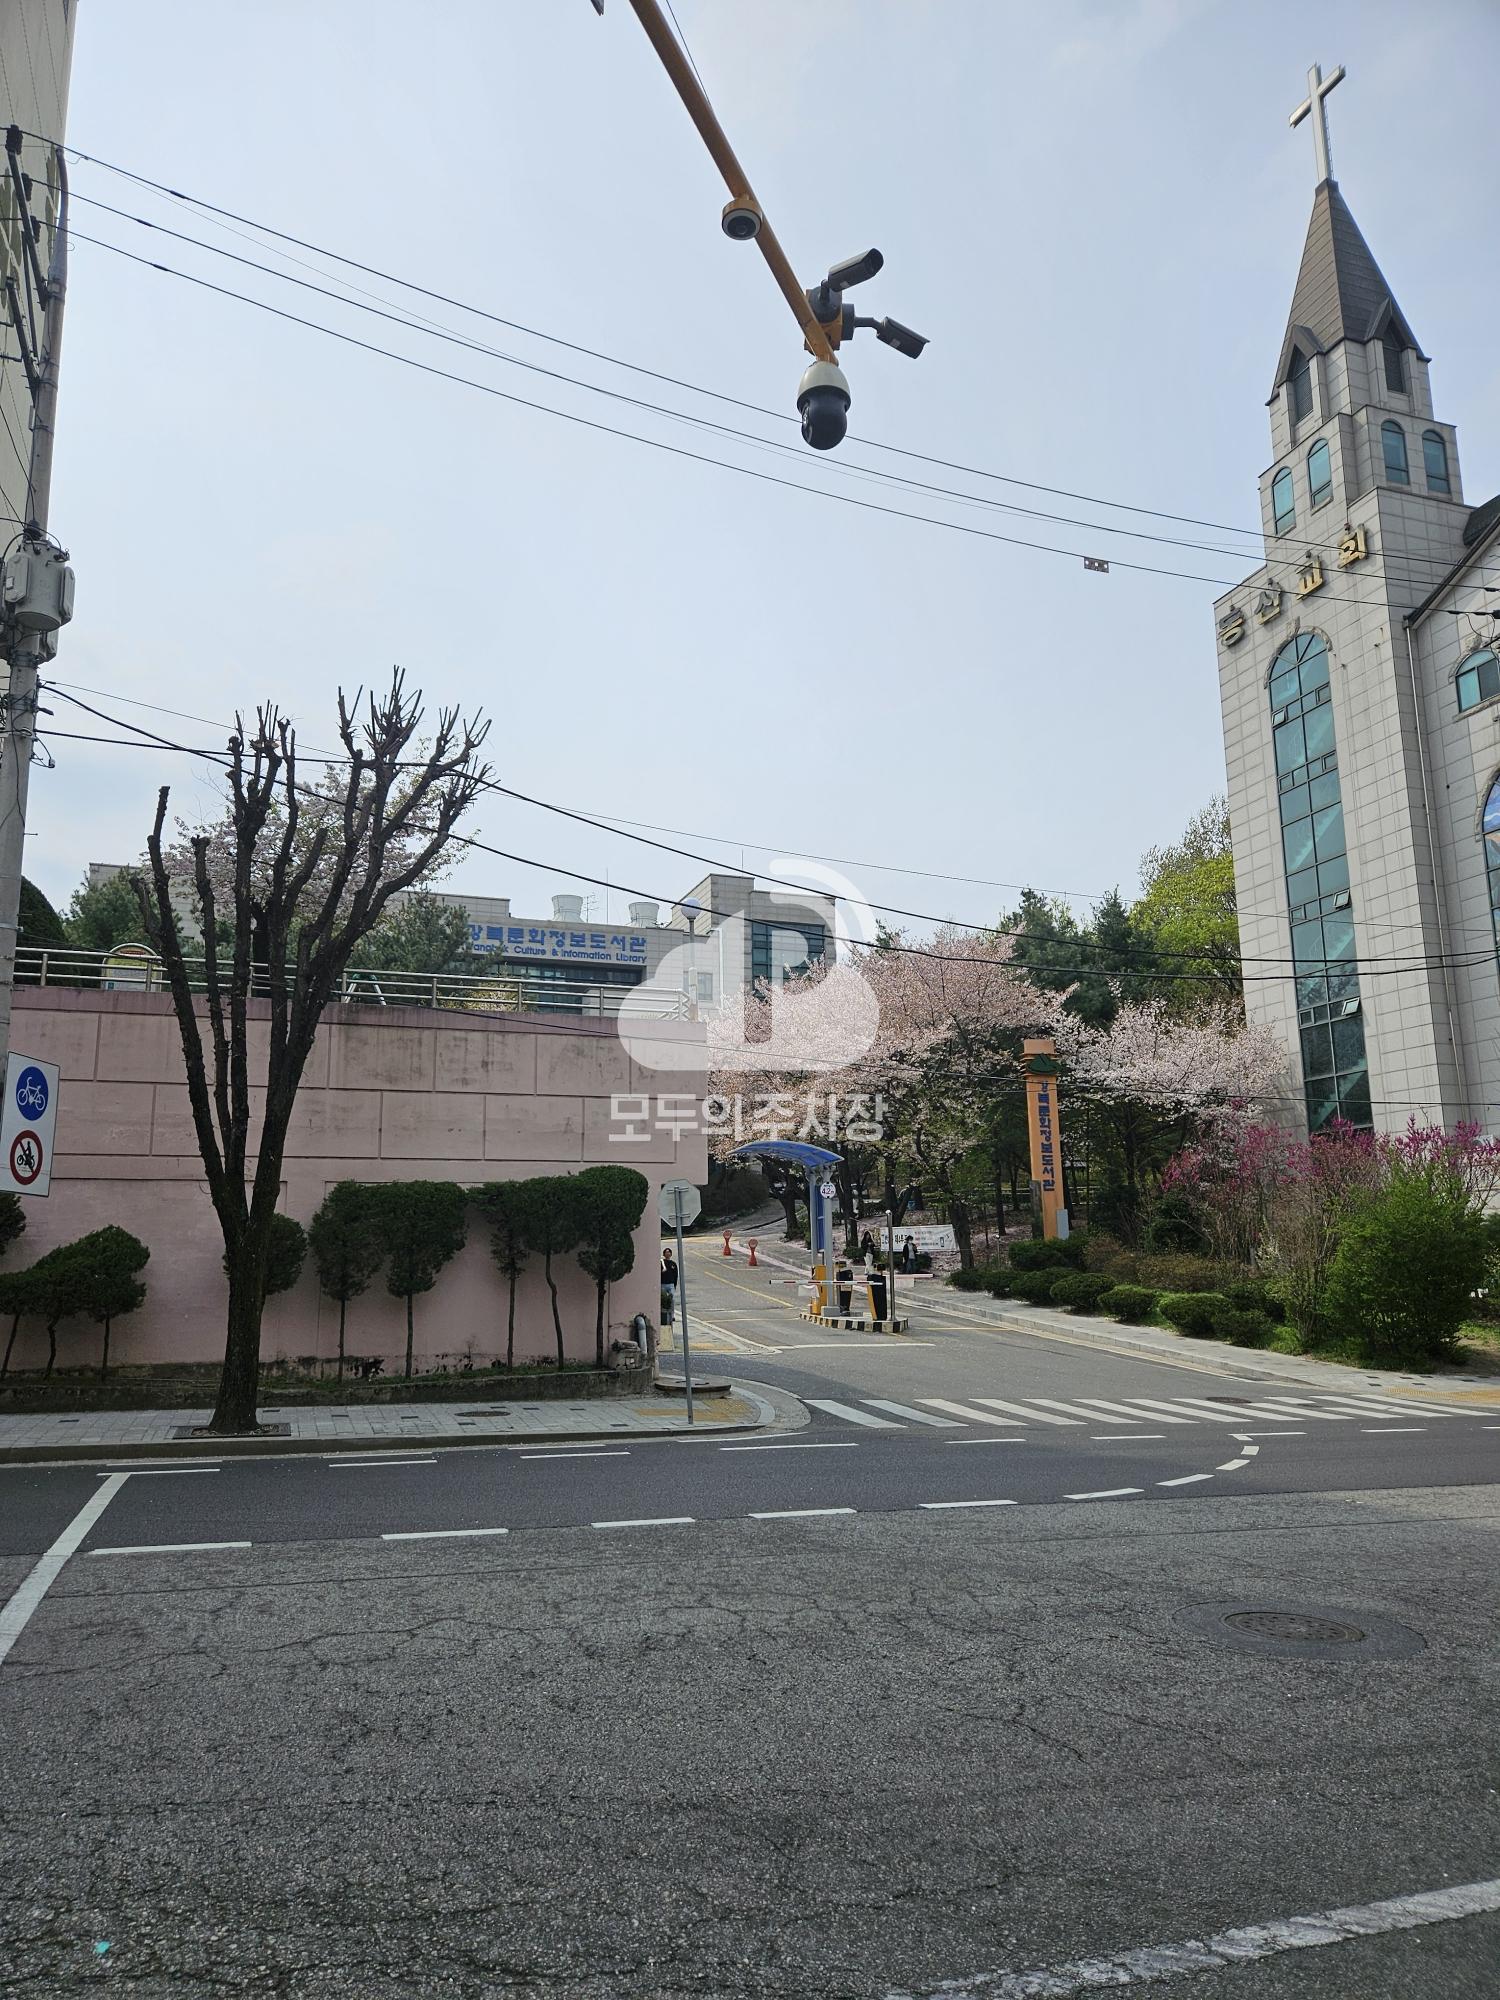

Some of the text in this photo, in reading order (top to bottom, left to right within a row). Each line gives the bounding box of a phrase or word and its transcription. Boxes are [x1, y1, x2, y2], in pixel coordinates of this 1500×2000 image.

[513, 944, 547, 957] Culture
[551, 948, 559, 957] &
[616, 952, 648, 964] Library
